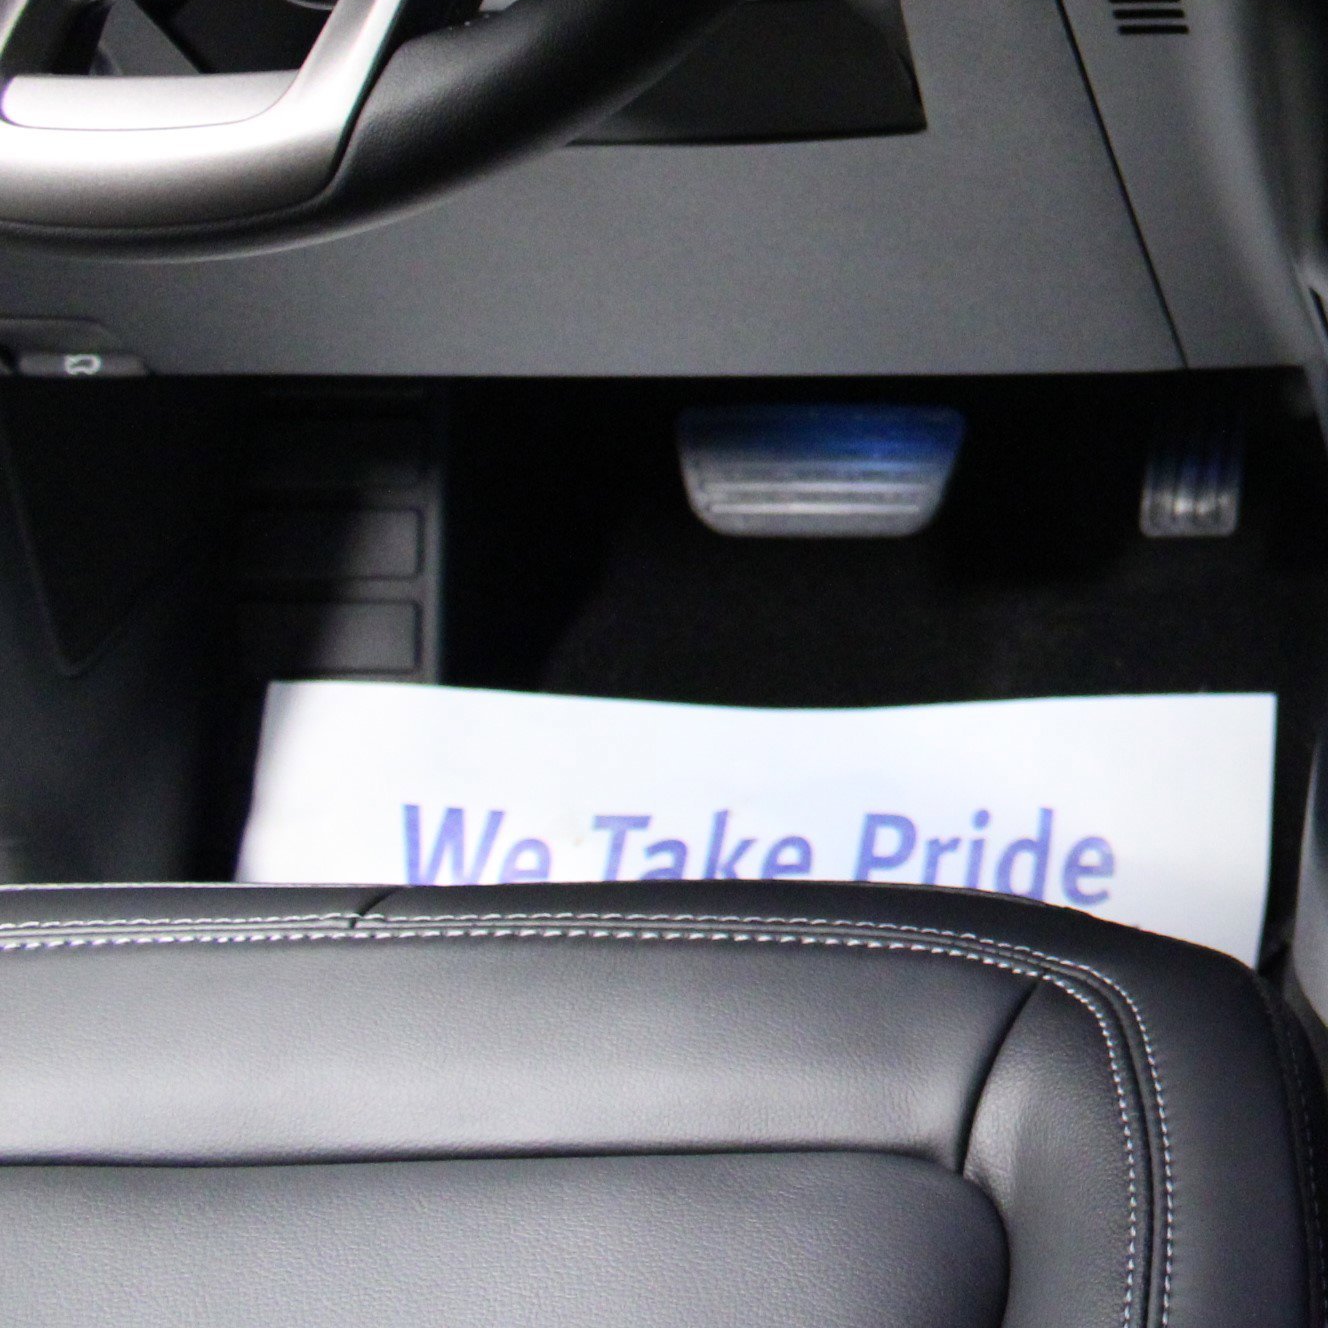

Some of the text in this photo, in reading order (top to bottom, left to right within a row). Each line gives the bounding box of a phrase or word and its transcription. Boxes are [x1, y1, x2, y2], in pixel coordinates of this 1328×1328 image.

[399, 804, 1116, 906] We Take Pride
